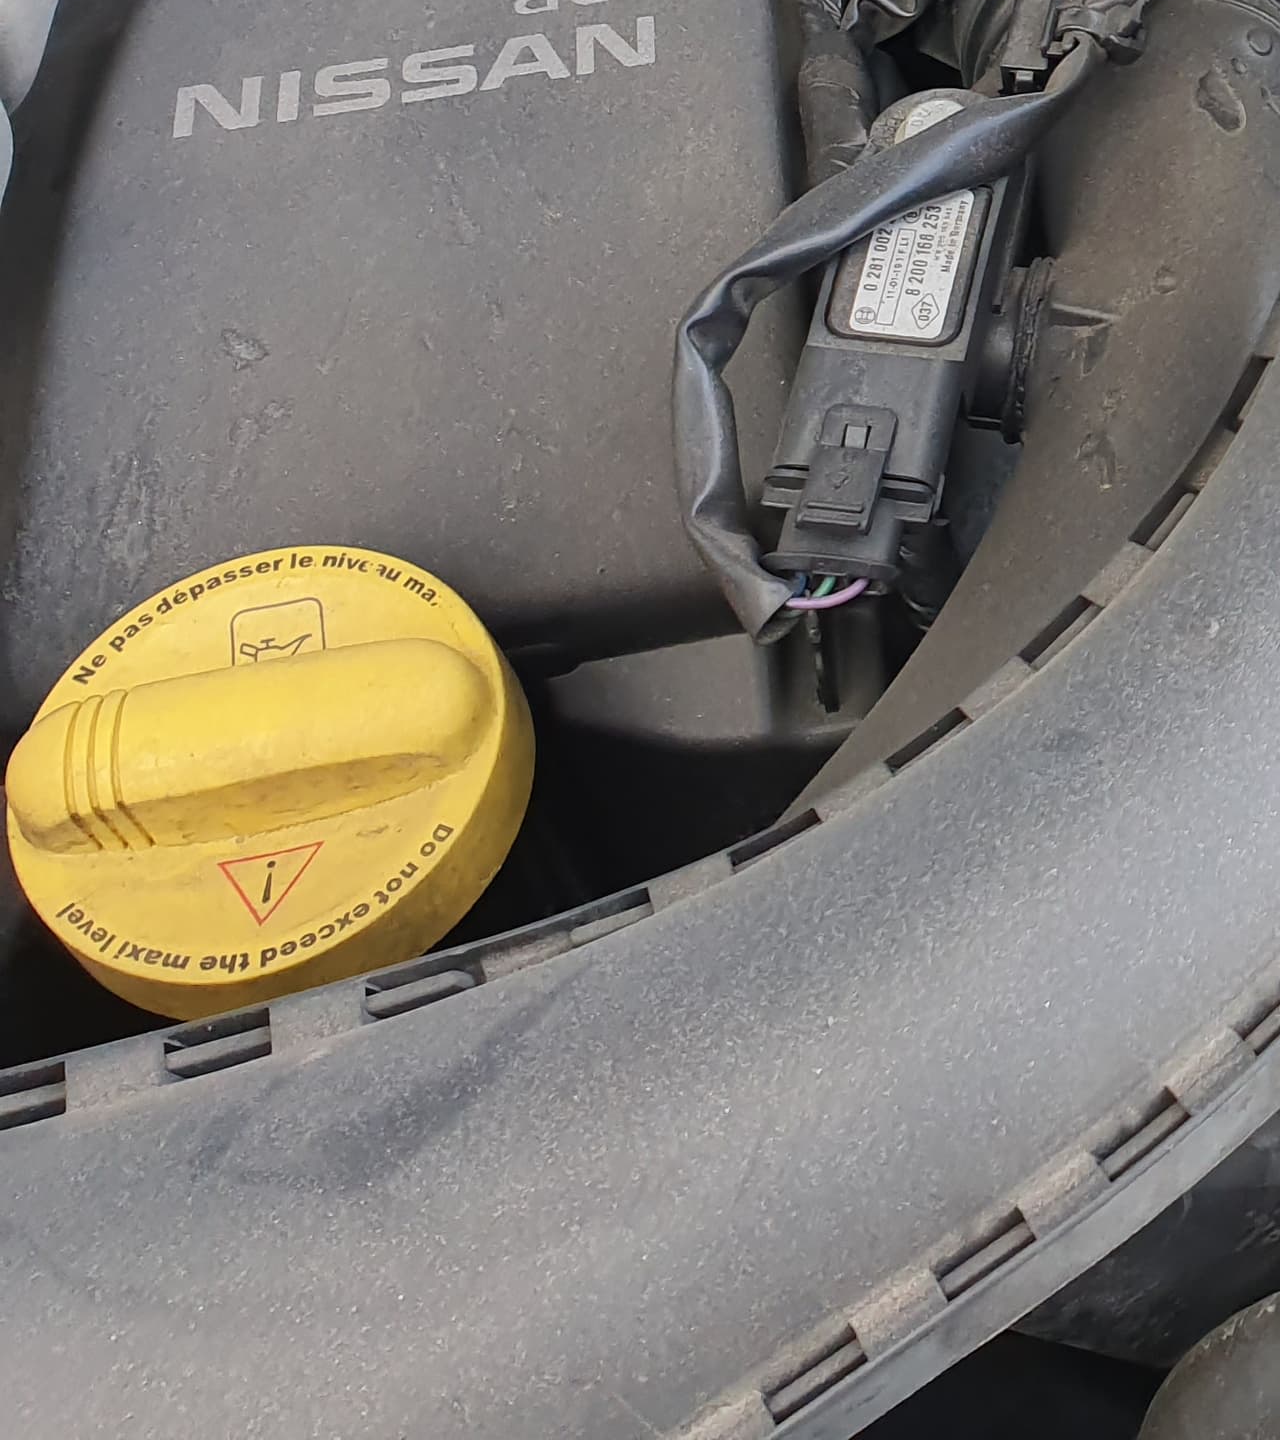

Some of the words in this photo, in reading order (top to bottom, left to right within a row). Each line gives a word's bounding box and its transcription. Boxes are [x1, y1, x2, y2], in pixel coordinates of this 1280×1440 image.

[172, 15, 657, 139] NISSAN
[921, 205, 942, 230] 253
[874, 227, 893, 253] 002
[915, 233, 935, 255] 168
[867, 257, 885, 279] 281
[908, 259, 929, 285] 200
[918, 301, 933, 322] 037
[71, 653, 108, 685] Ne
[108, 612, 154, 653] pas
[155, 558, 284, 615] dépasser
[289, 553, 314, 569] le
[419, 822, 455, 858] Do
[373, 861, 420, 905] not
[55, 901, 112, 953] level
[259, 901, 371, 970] exceed
[113, 939, 191, 972] maxi
[199, 952, 251, 974] the
